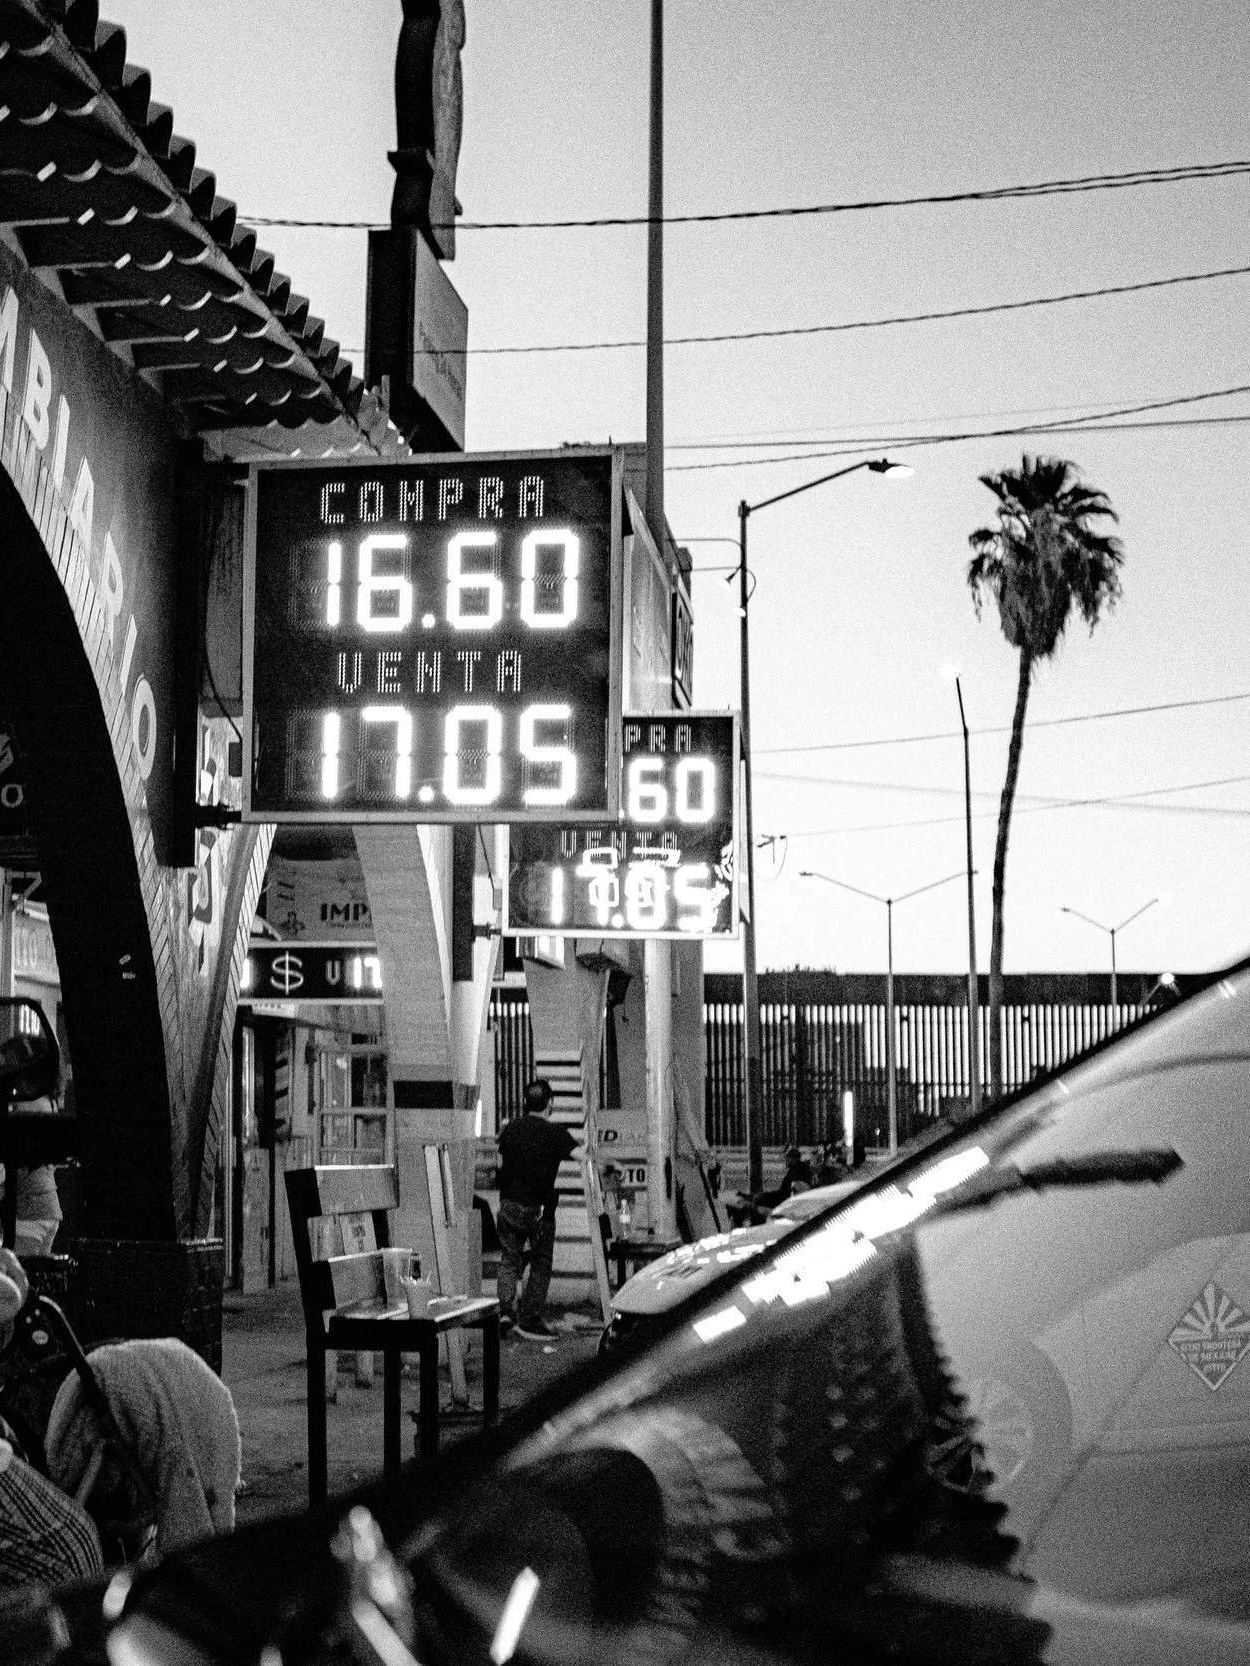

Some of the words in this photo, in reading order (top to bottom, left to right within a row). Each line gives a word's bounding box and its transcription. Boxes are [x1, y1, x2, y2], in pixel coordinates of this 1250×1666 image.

[320, 476, 546, 523] COMPRA
[326, 529, 580, 632] 16.60
[338, 650, 522, 693] VENTA
[322, 704, 577, 806] 17.05
[625, 723, 692, 753] PRA
[320, 902, 373, 921] IMP
